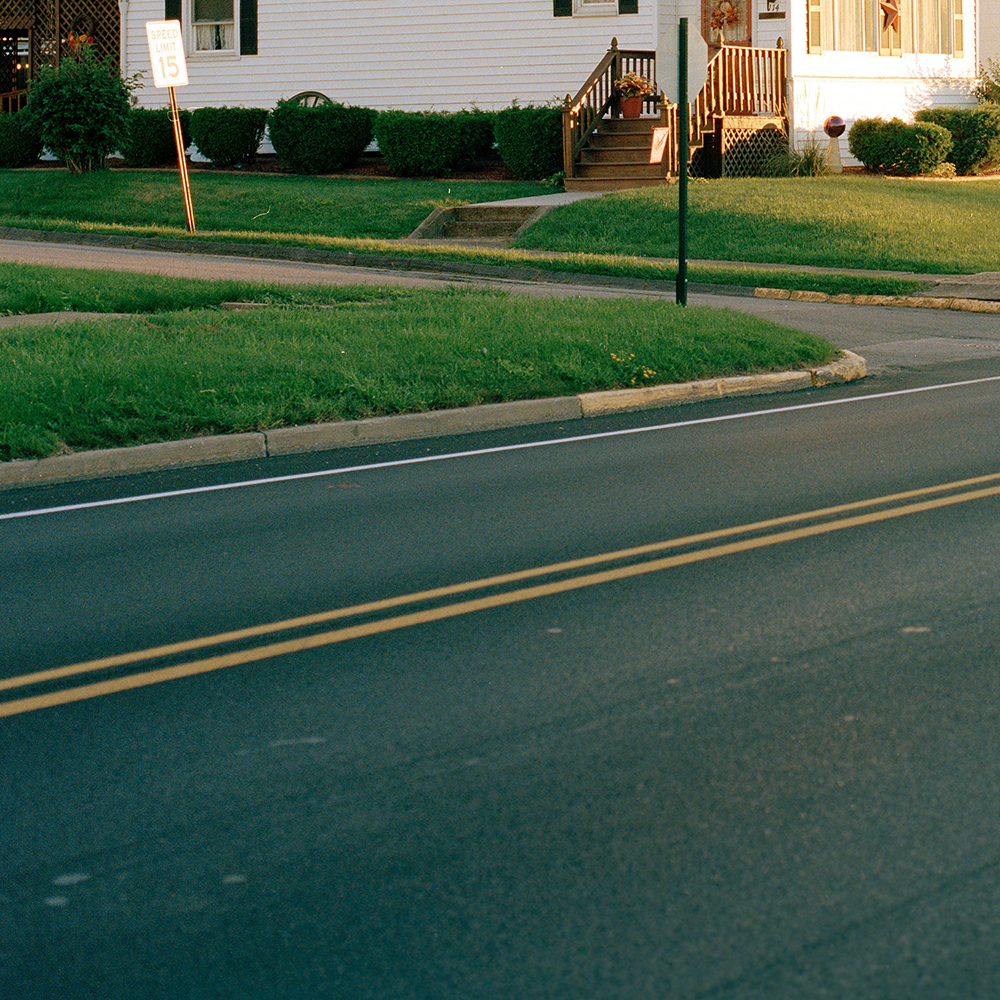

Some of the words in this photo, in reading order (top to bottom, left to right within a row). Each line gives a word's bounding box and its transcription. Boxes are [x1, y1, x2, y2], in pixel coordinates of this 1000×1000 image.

[151, 28, 178, 40] SPEED
[155, 42, 176, 53] LIMIT
[158, 55, 180, 79] 15
